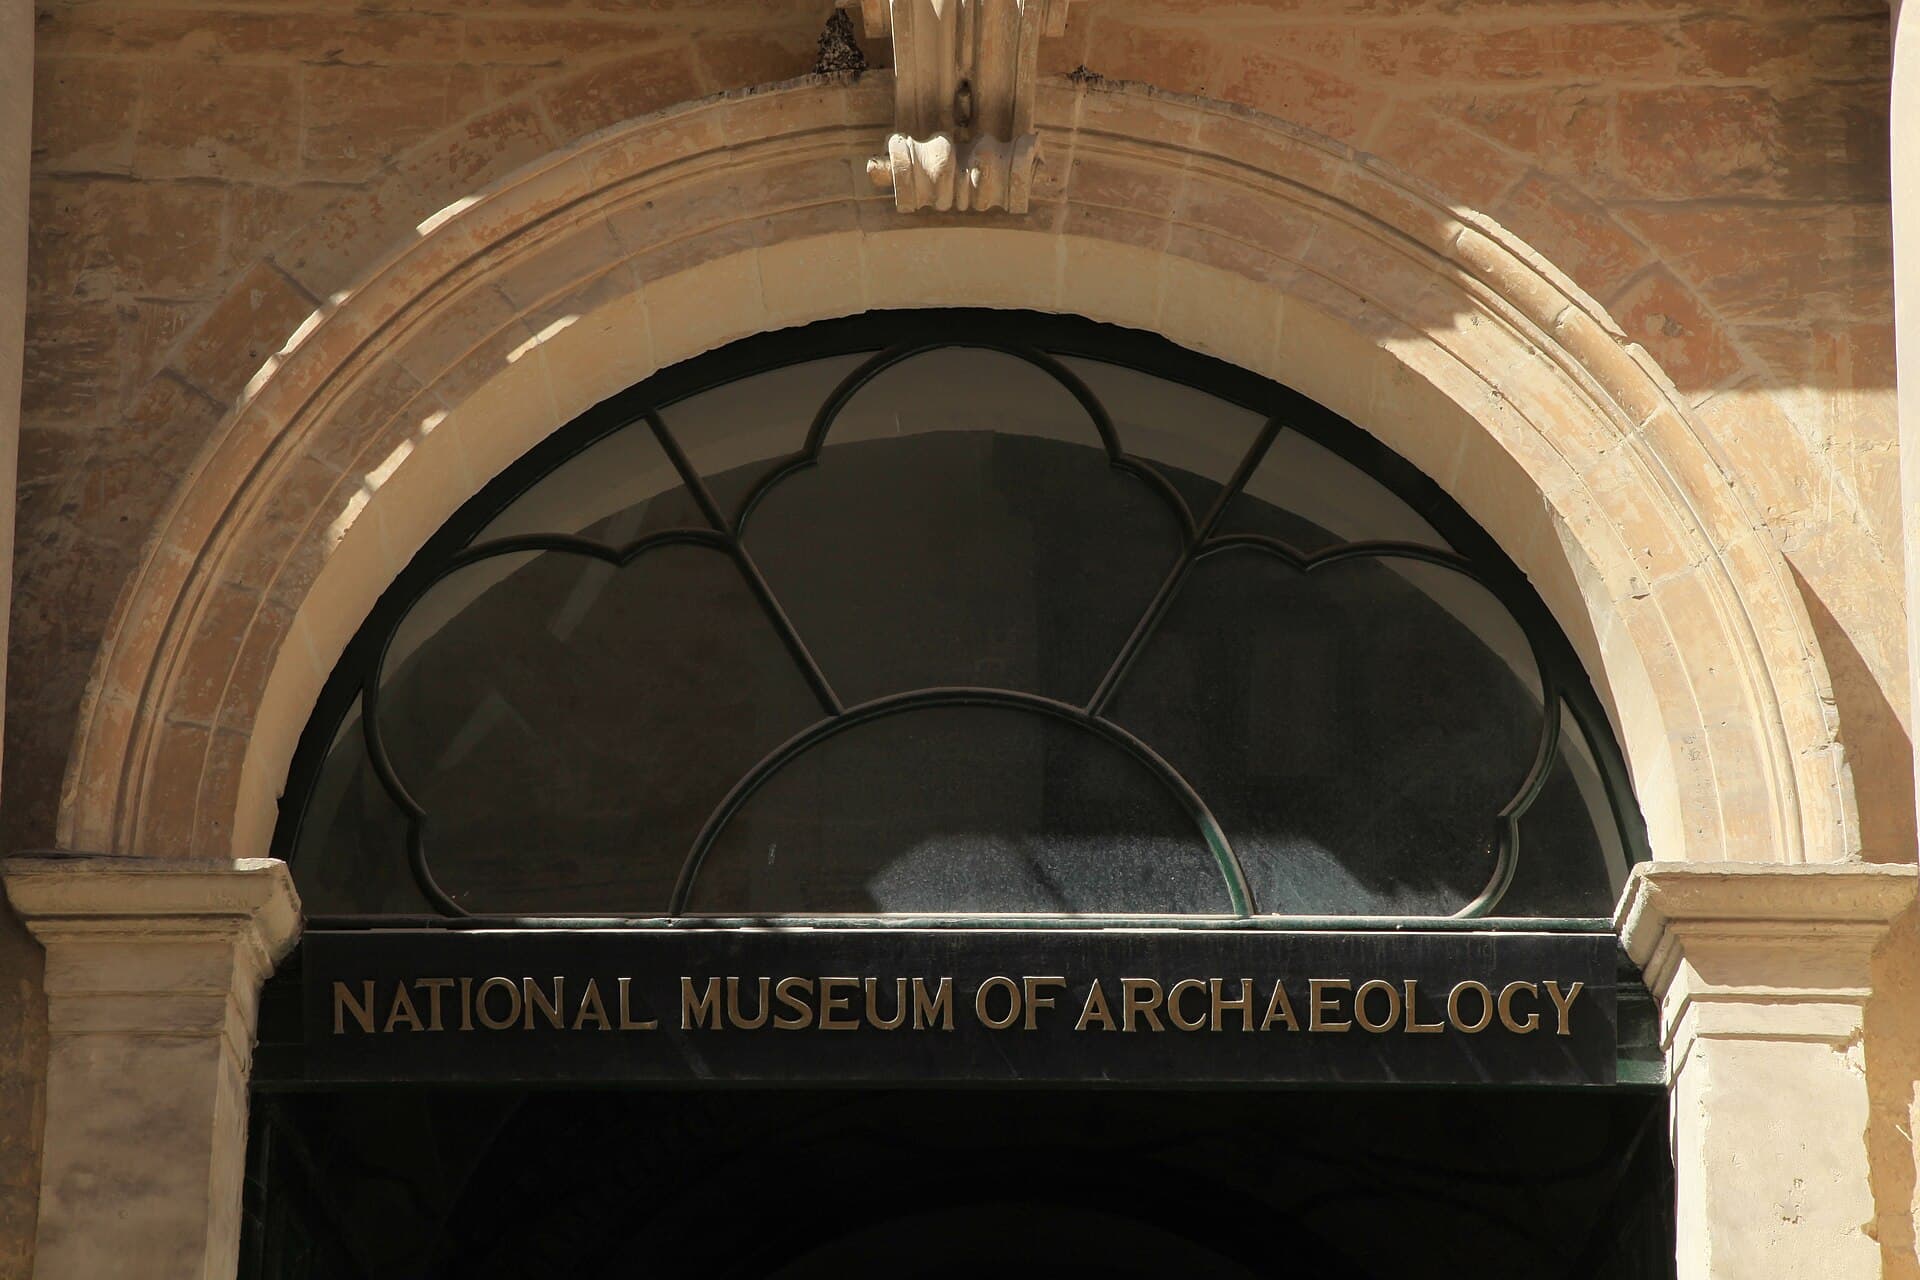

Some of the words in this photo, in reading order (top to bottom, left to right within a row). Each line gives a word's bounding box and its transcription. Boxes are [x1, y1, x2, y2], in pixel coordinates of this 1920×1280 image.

[333, 976, 658, 1033] NATIONAL
[681, 976, 954, 1031] MUSEUM
[975, 976, 1067, 1031] OF
[1075, 977, 1584, 1036] ARCHAEOLOGY
